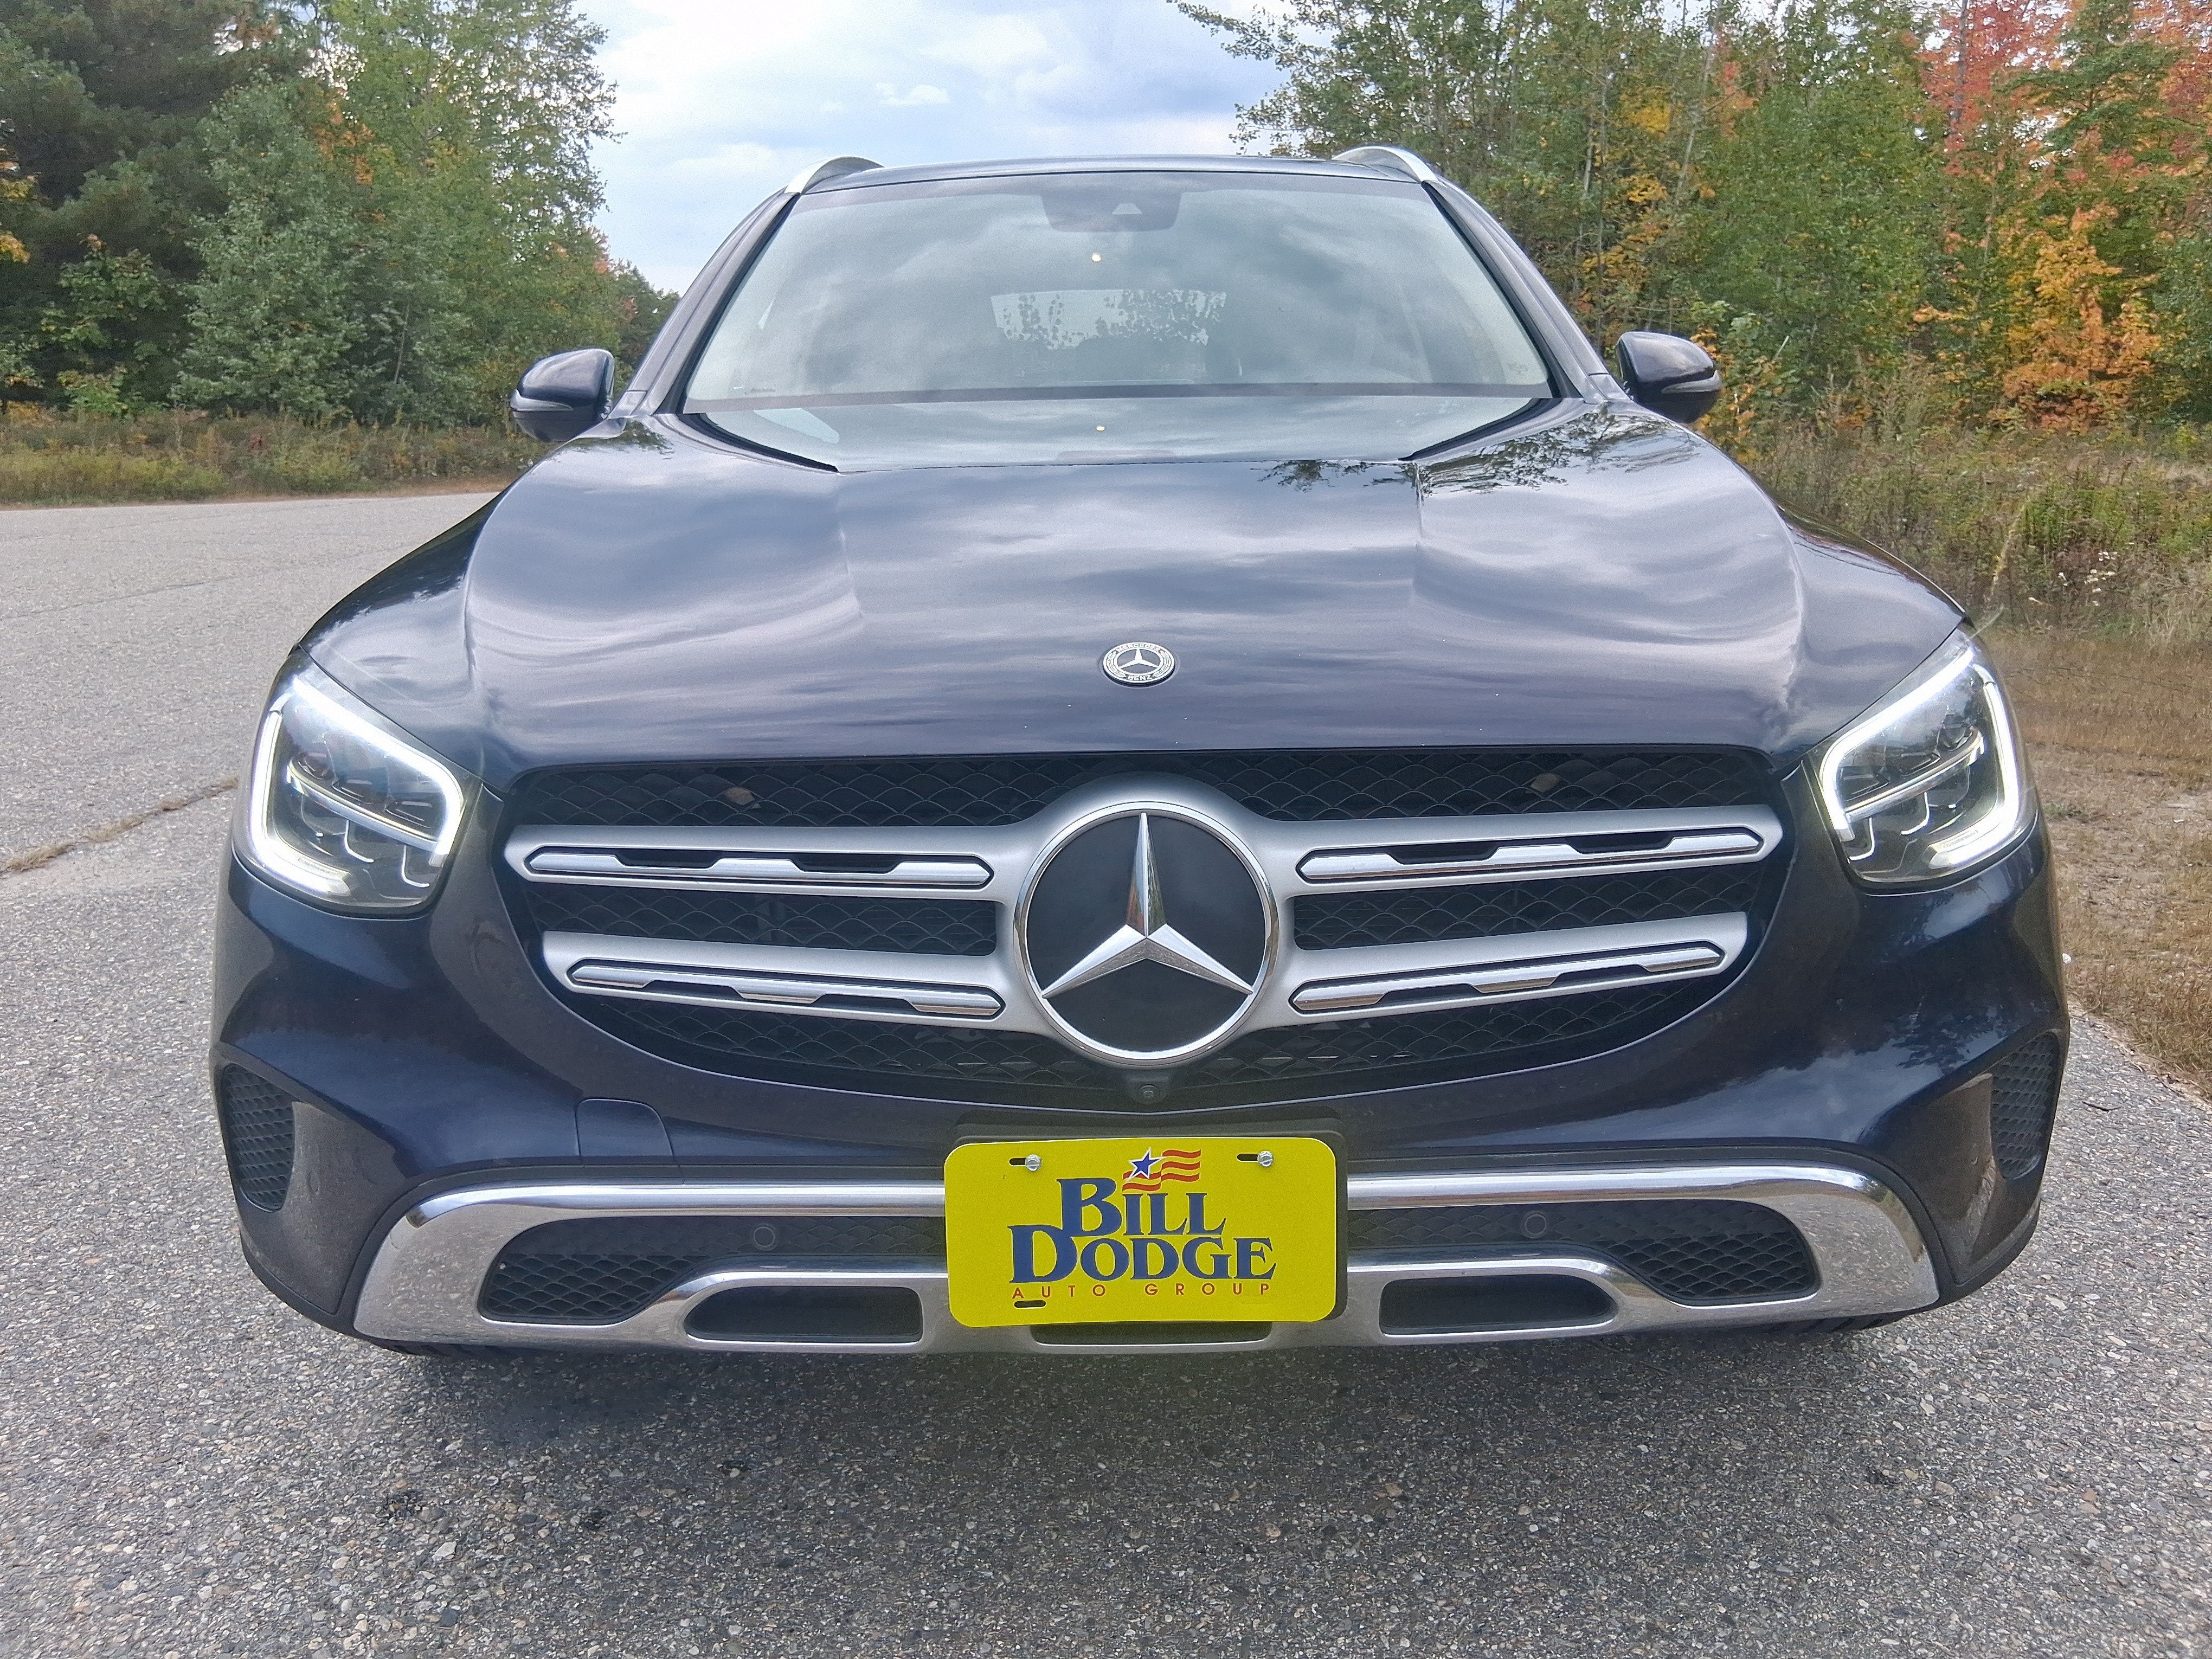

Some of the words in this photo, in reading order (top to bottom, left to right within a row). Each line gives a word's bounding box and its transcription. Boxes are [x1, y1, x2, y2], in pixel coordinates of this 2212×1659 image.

[1116, 644, 1161, 652] MERCEDES
[1056, 1177, 1227, 1237] BILL
[1007, 1224, 1277, 1284] DODGE
[1012, 1284, 1107, 1300] AUTO
[1144, 1283, 1270, 1297] GROUP
